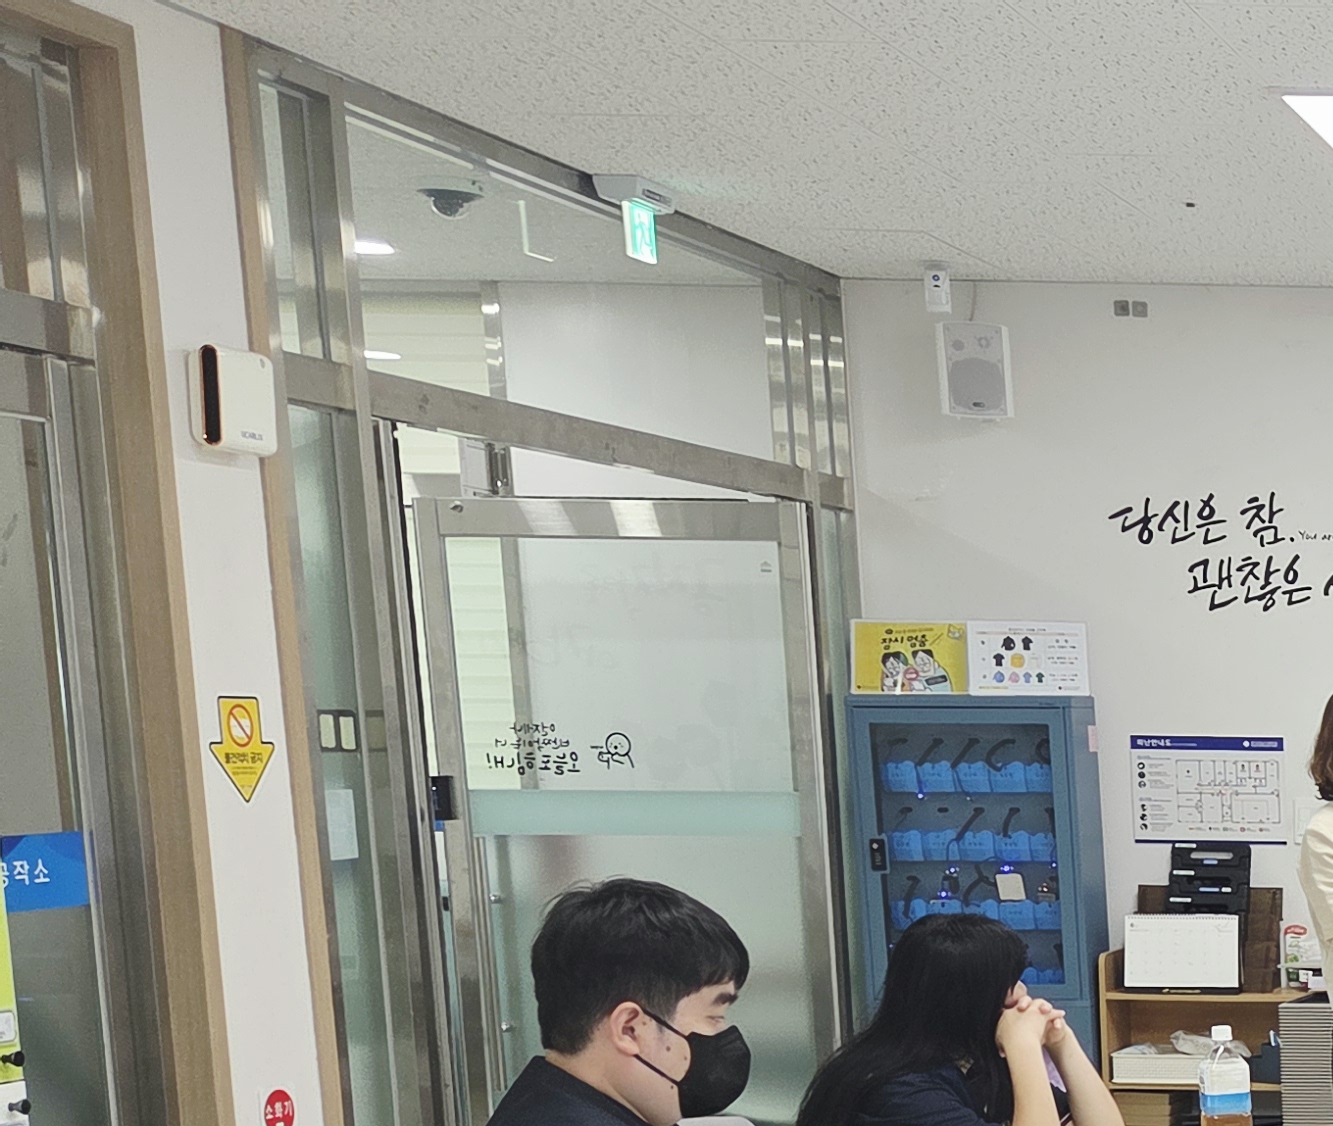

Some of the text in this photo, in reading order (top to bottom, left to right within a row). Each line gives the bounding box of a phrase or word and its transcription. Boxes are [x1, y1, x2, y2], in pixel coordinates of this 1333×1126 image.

[1108, 491, 1296, 547] 당신은 참.
[1298, 530, 1318, 542] You
[1187, 554, 1313, 612] 괜찮은
[265, 1099, 293, 1120] 소화기
